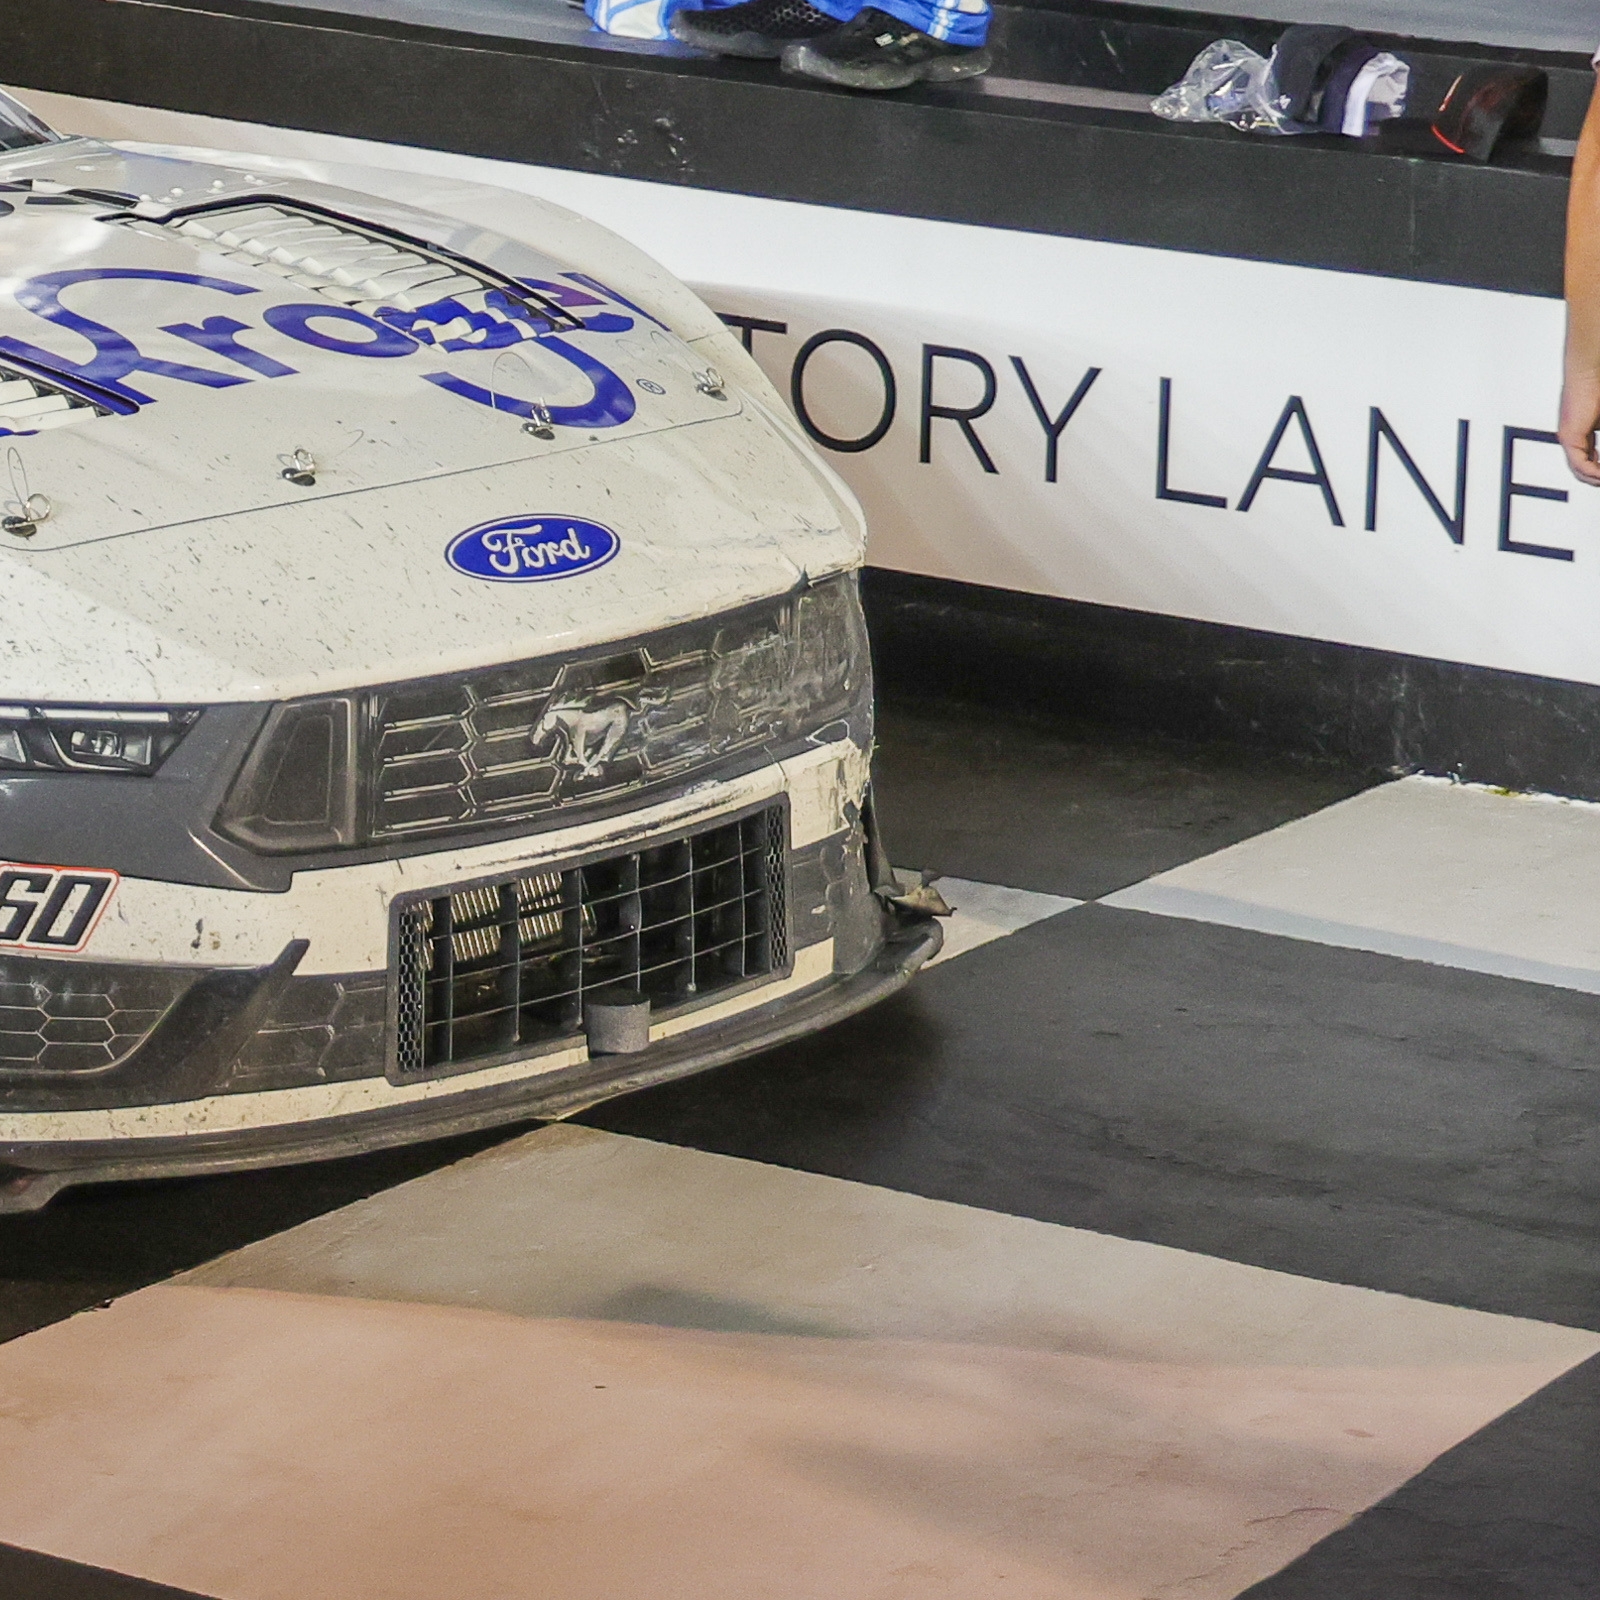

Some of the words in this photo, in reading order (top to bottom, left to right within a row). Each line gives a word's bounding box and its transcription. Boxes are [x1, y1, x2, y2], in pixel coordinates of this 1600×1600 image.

[716, 311, 1102, 485] TORY
[1155, 376, 1577, 563] LANE
[485, 521, 593, 574] Ford
